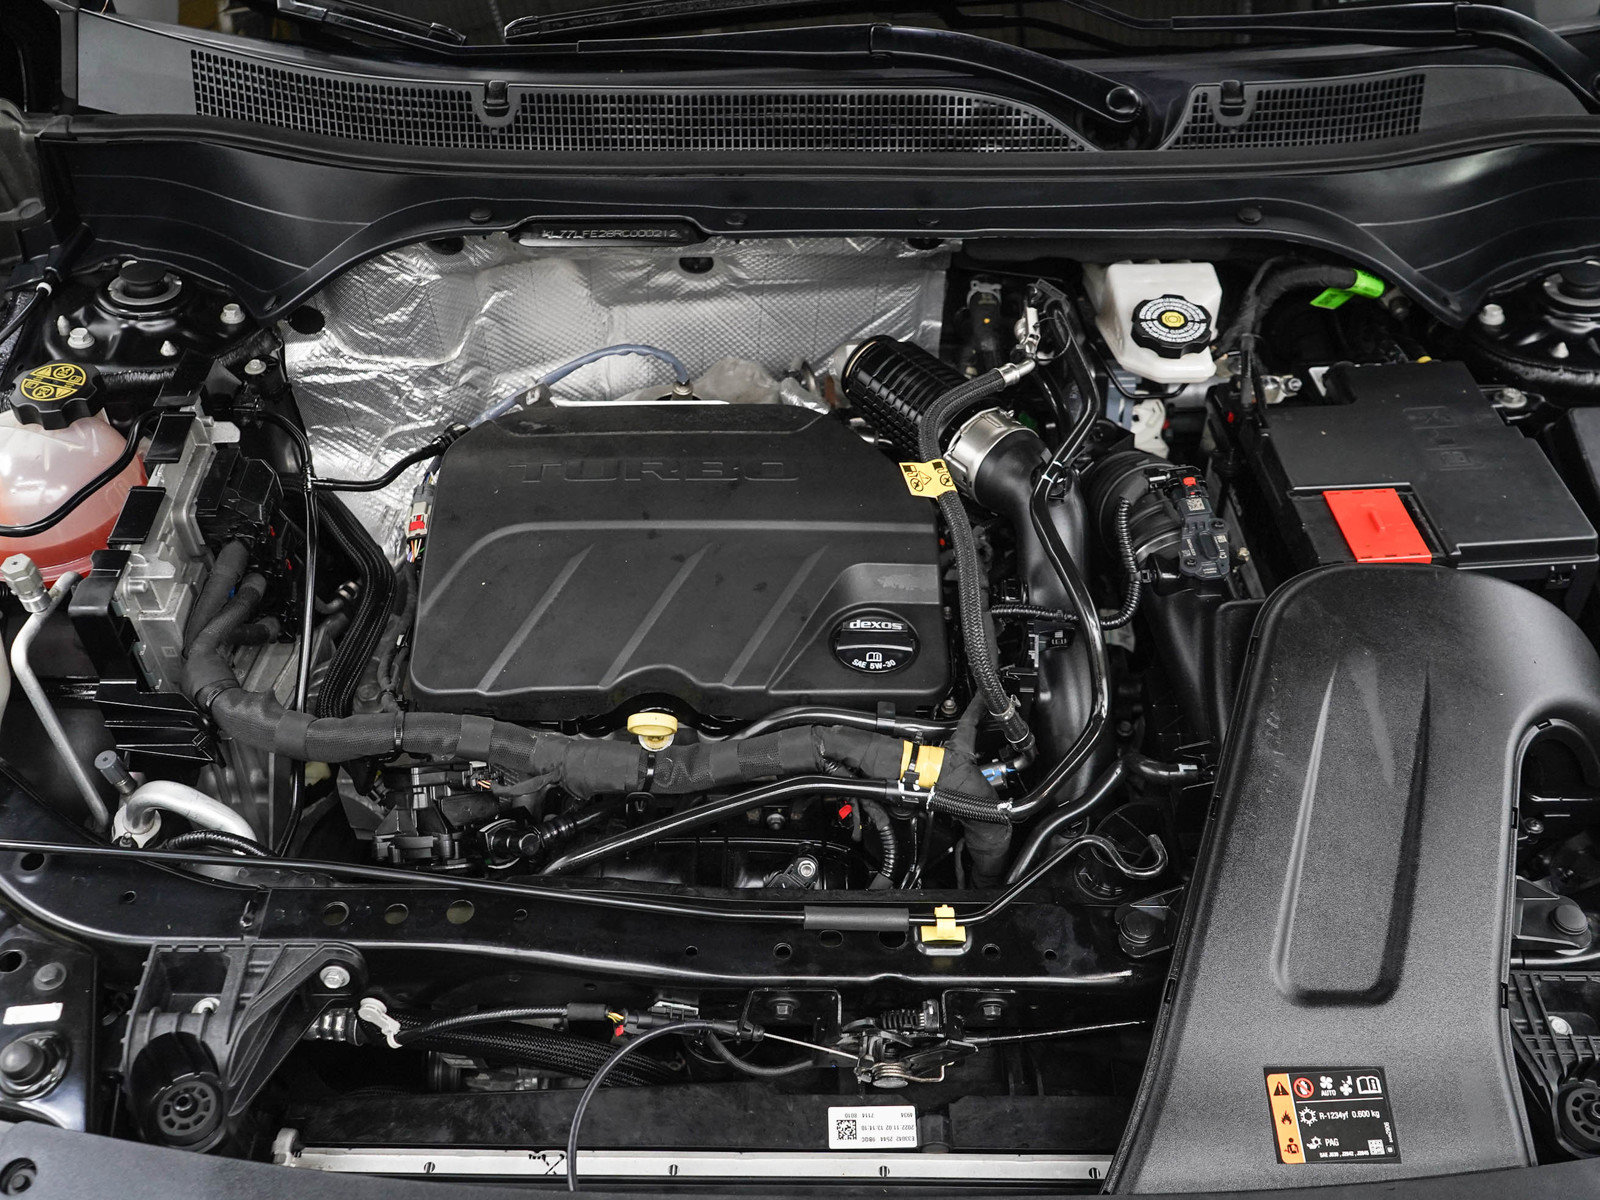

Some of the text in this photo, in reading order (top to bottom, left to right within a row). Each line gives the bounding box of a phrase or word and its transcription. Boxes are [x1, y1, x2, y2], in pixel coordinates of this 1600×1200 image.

[507, 461, 799, 483] TURBO
[849, 620, 904, 630] dexos
[852, 659, 896, 669] SAE 5W-30
[1321, 1089, 1336, 1097] AUTO
[1319, 1111, 1349, 1121] R-1234yf
[1371, 1109, 1380, 1119] kg
[1324, 1138, 1339, 1147] PAG
